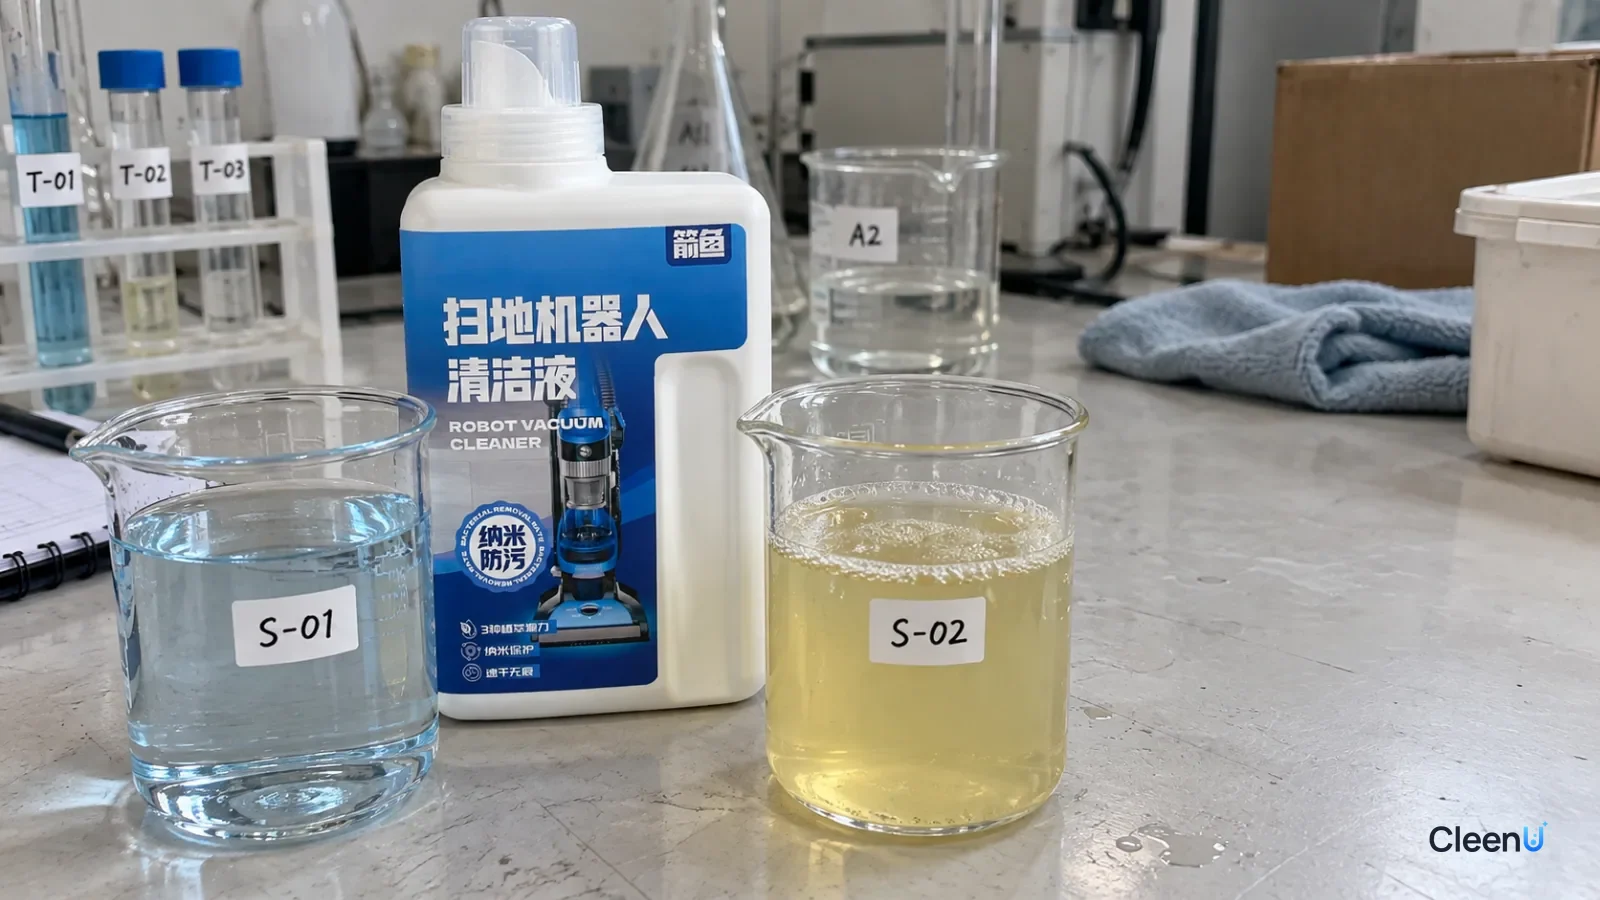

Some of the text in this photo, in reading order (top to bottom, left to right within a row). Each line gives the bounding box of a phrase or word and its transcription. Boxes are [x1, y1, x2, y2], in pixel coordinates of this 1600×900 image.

[26, 169, 76, 193] T-01
[120, 164, 168, 185] T-02
[199, 159, 246, 182] T-03
[672, 228, 726, 260] 箭鱼
[849, 222, 883, 248] A2
[443, 294, 669, 346] 扫地机器人
[447, 355, 577, 404] 清洁液
[449, 416, 604, 433] ROBOT VACUUM
[450, 437, 542, 451] CLEANER
[477, 524, 527, 549] 纳米
[480, 547, 527, 573] 防污
[258, 609, 333, 648] S-01
[890, 618, 968, 648] S-02
[484, 644, 534, 657] 纳米保护
[486, 666, 534, 678] 速干无痕
